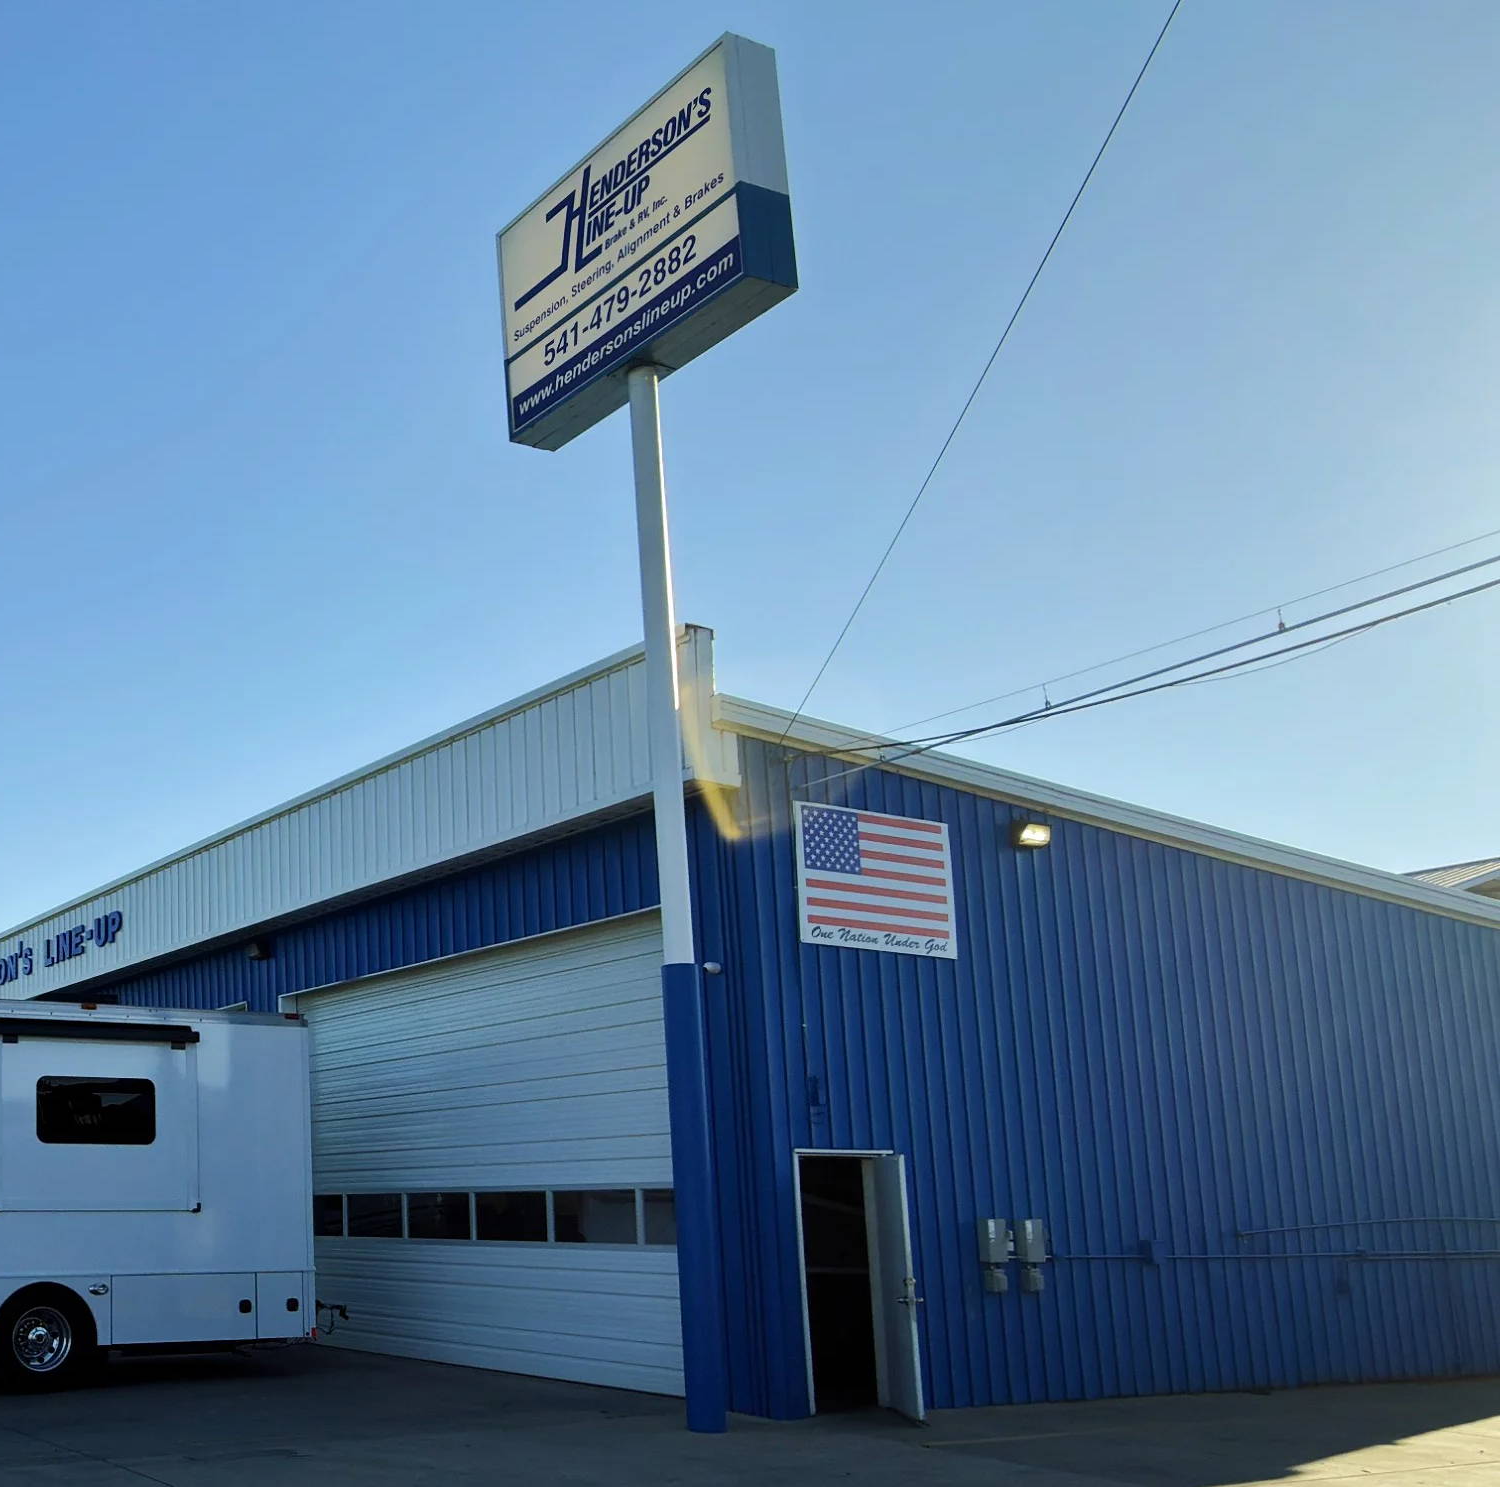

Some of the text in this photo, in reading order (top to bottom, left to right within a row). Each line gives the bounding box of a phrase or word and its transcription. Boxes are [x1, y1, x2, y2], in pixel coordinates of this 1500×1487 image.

[546, 87, 712, 274] HENDERSON'S
[604, 227, 627, 251] Brake
[629, 217, 636, 230] &
[652, 196, 668, 212] Inc.
[513, 172, 724, 342] Suspension, Steering, Alignment & Brakes
[543, 234, 697, 367] 541-479-2882
[518, 252, 734, 416] www.hendersonslineup.com
[43, 910, 123, 968] LINE-UP
[811, 926, 949, 955] One Nation Under God
